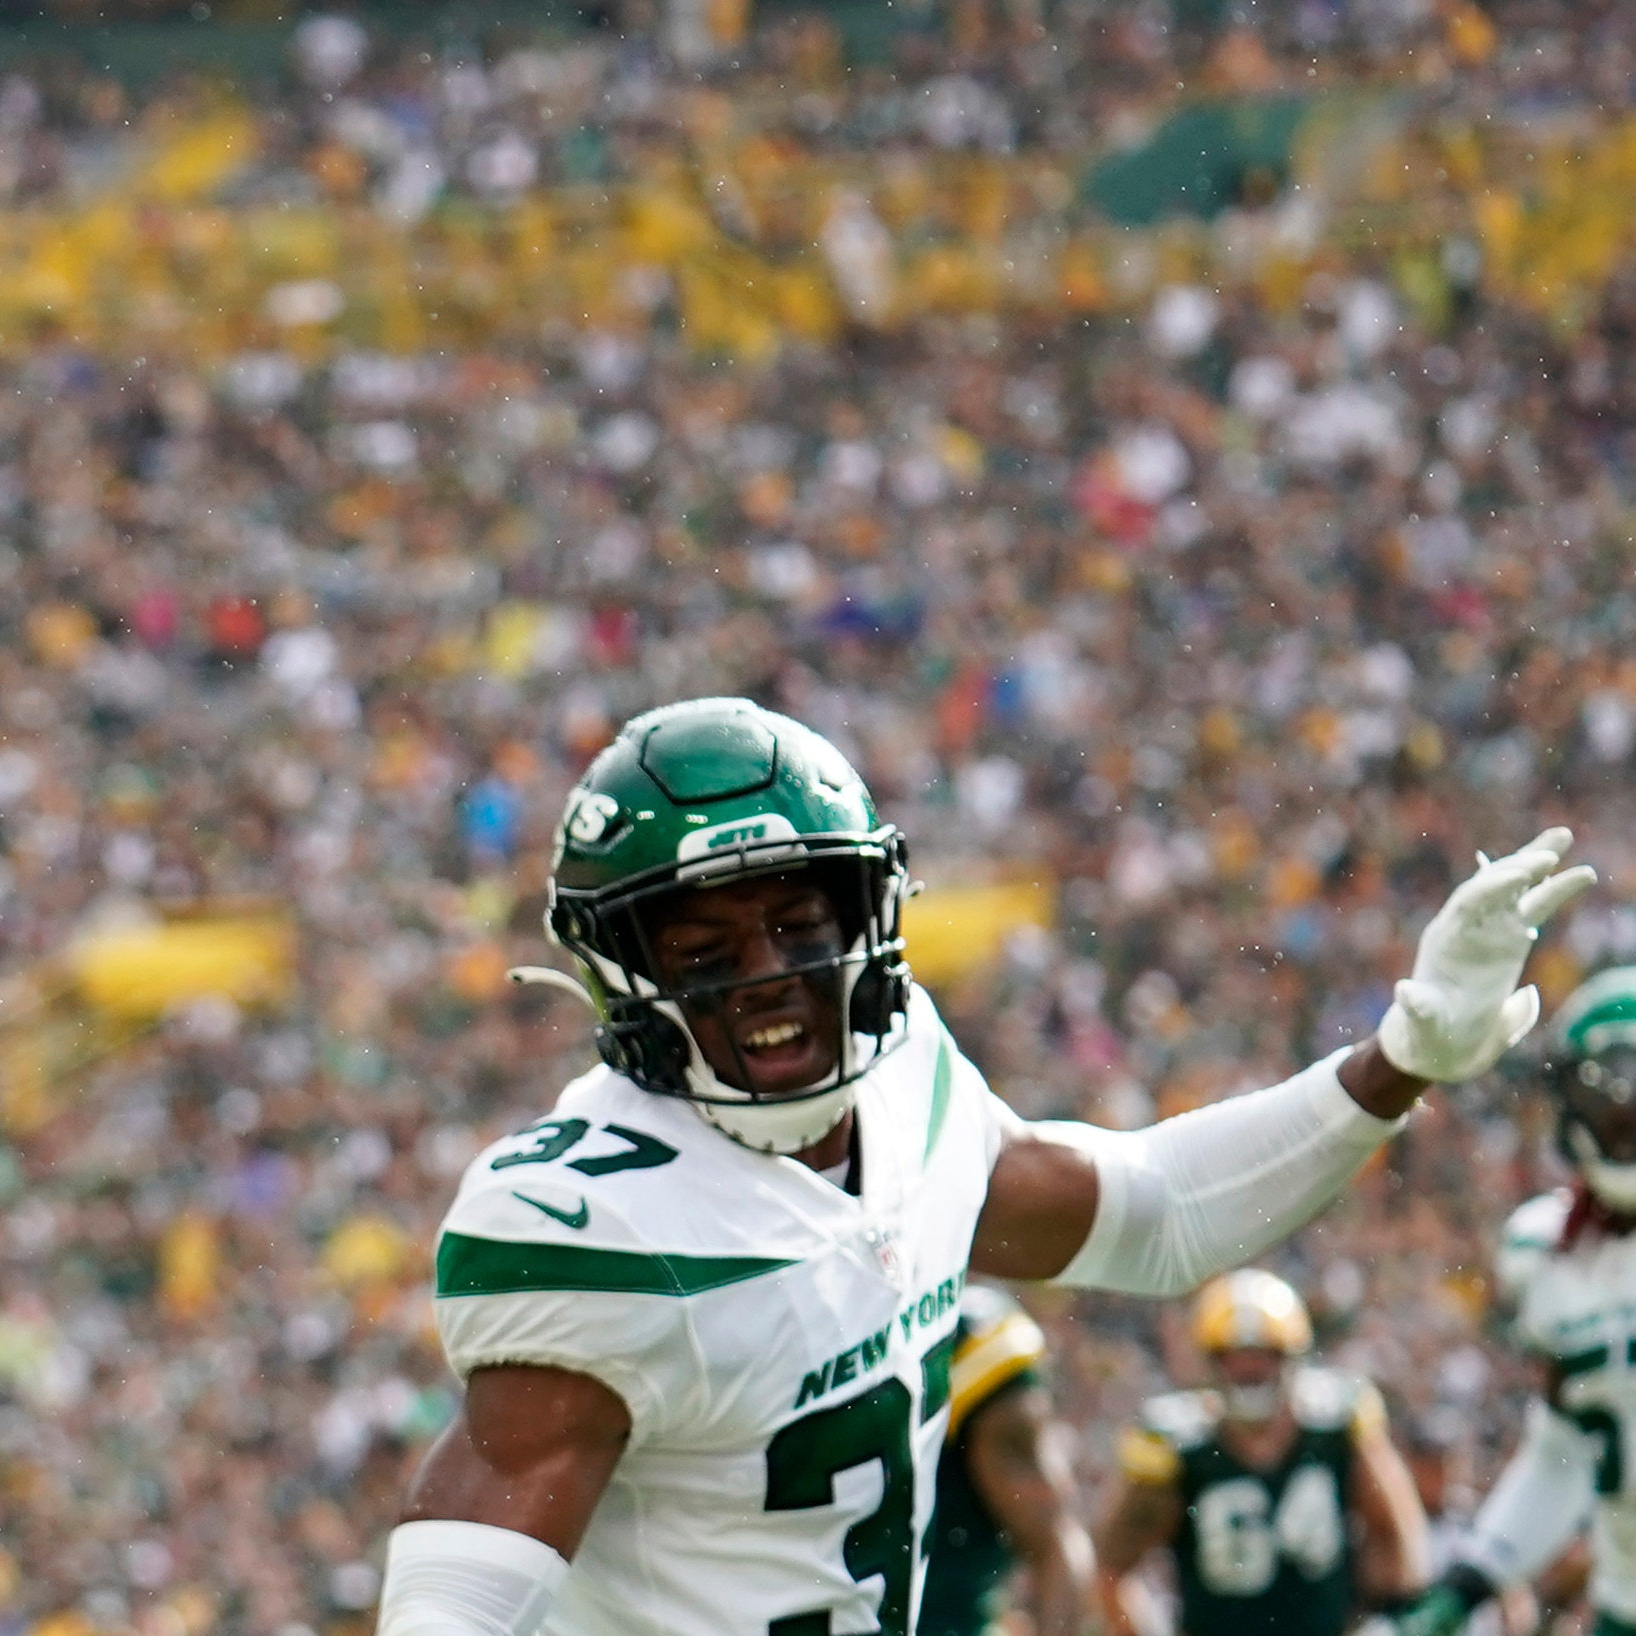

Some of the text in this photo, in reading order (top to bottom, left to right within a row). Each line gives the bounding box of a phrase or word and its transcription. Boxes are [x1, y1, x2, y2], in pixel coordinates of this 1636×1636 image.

[490, 1117, 681, 1178] 37
[793, 1320, 893, 1410] NEW
[1552, 1338, 1636, 1494] 5
[1195, 1462, 1344, 1597] 64
